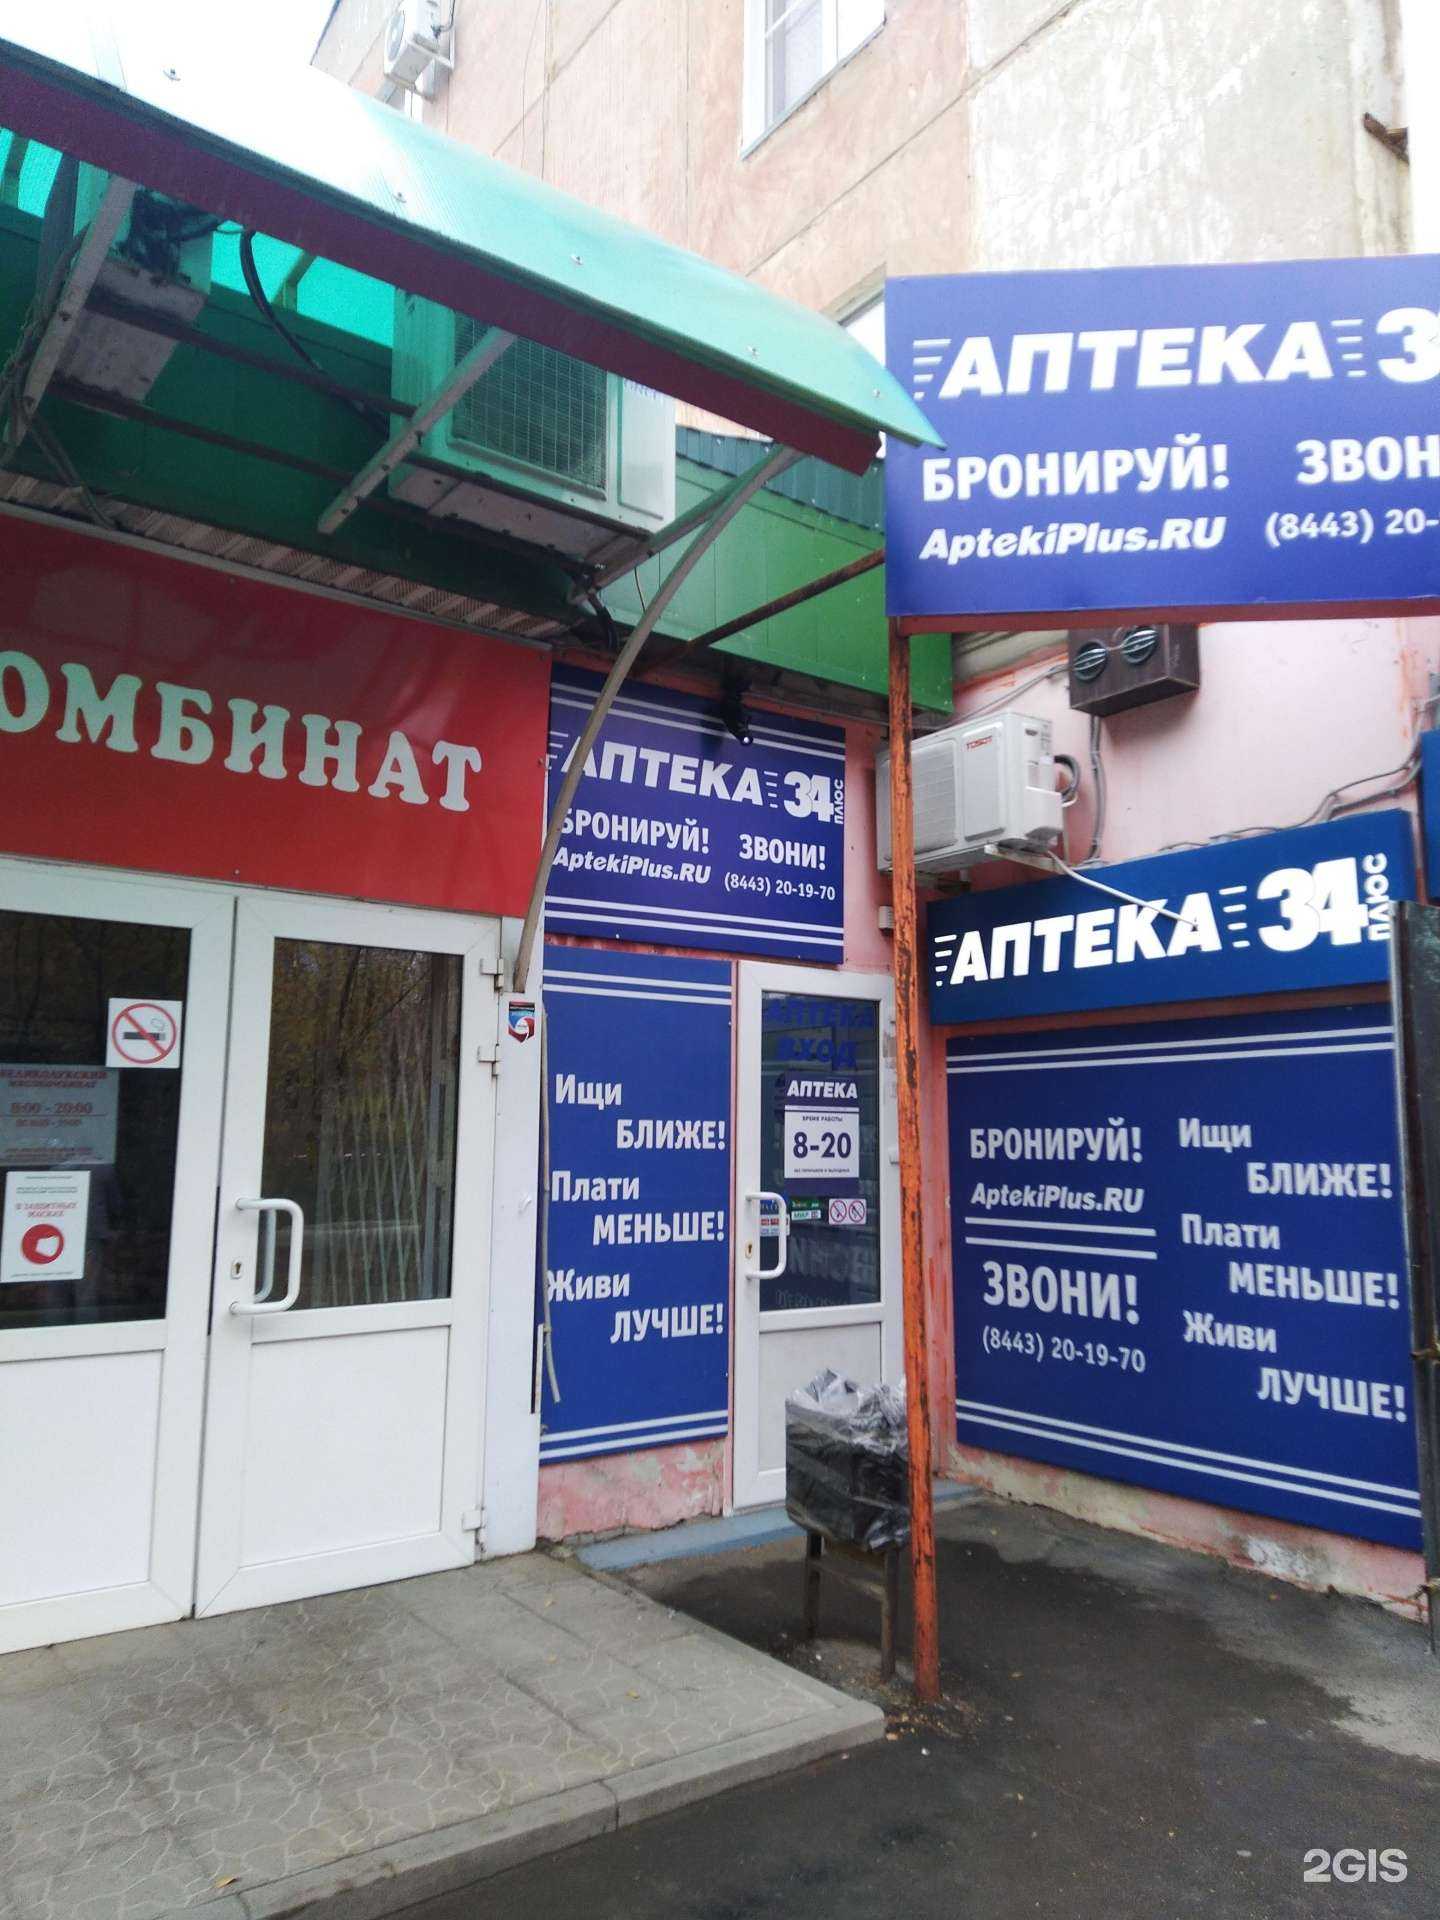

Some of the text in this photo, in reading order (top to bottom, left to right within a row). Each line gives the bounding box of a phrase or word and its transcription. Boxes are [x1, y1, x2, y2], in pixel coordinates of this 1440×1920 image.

[939, 307, 1440, 400] АПТЕКА 3
[922, 432, 1230, 502] БРОНИРУЙ!
[919, 516, 1226, 566] AptekiPlus.RU
[1265, 508, 1375, 548] (8443)
[560, 736, 844, 825] АПТЕКА 34 ПЛЮС
[561, 808, 826, 871] БРОНИРУЙ! ЗВОНИ!
[552, 846, 836, 901] AptekiPlus.RU (8443) 20-19-70
[950, 852, 1393, 985] АПТЕКА 34 ПЛЮС
[555, 1074, 622, 1110] Ищи
[787, 1080, 858, 1099] АПТЕКА
[616, 1119, 726, 1150] БЛИЖЕ!
[793, 1131, 852, 1159] 8-20
[969, 1116, 1144, 1163] БРОНИРУЙ!
[1178, 1117, 1253, 1154] Ищи
[551, 1170, 641, 1202] Плати
[970, 1183, 1145, 1214] AptekiPlus.RU
[1246, 1161, 1393, 1199] БЛИЖЕ!
[592, 1211, 725, 1246] МЕНЬШЕ!
[1181, 1213, 1281, 1251] Плати
[547, 1268, 630, 1303] Живи
[982, 1260, 1141, 1326] ЗВОНИ!
[1228, 1261, 1401, 1310] МЕНЬШЕ!
[610, 1303, 724, 1344] ЛУЧШЕ!
[1182, 1309, 1278, 1354] Живи
[982, 1325, 1146, 1373] (8443) 20-19-70
[1257, 1366, 1408, 1423] ЛУЧШЕ!
